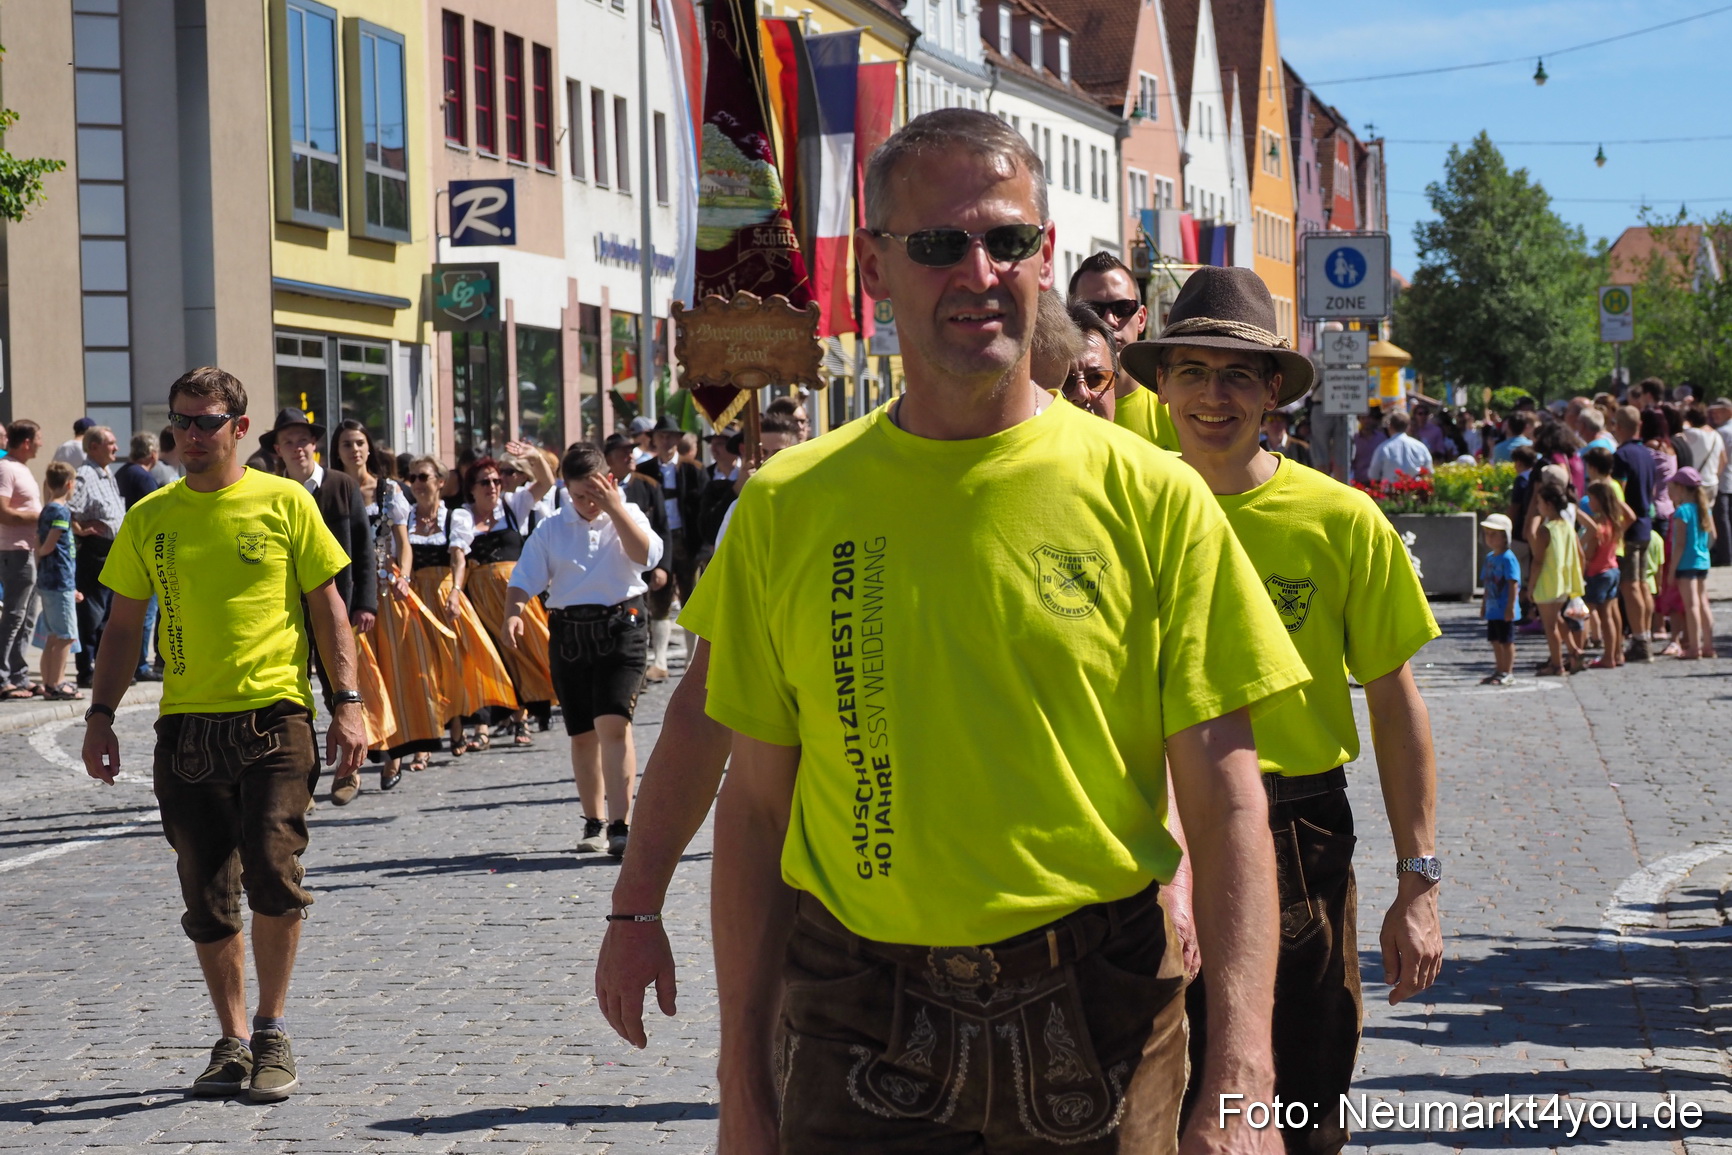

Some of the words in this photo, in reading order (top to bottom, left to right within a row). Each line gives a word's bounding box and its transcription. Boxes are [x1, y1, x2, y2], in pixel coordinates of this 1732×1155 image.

[1325, 296, 1366, 310] ZONE
[154, 532, 165, 560] 2018
[166, 531, 181, 602] WEIDENWANG
[831, 540, 856, 603] 2018
[1042, 575, 1052, 584] 19
[861, 536, 887, 698] WEIDENWANG
[175, 625, 185, 660] JAHRE
[831, 609, 874, 880] GAUSCHÜTZENFEST
[865, 704, 888, 749] SSV
[871, 754, 894, 835] JAHRE
[874, 842, 892, 877] 40
